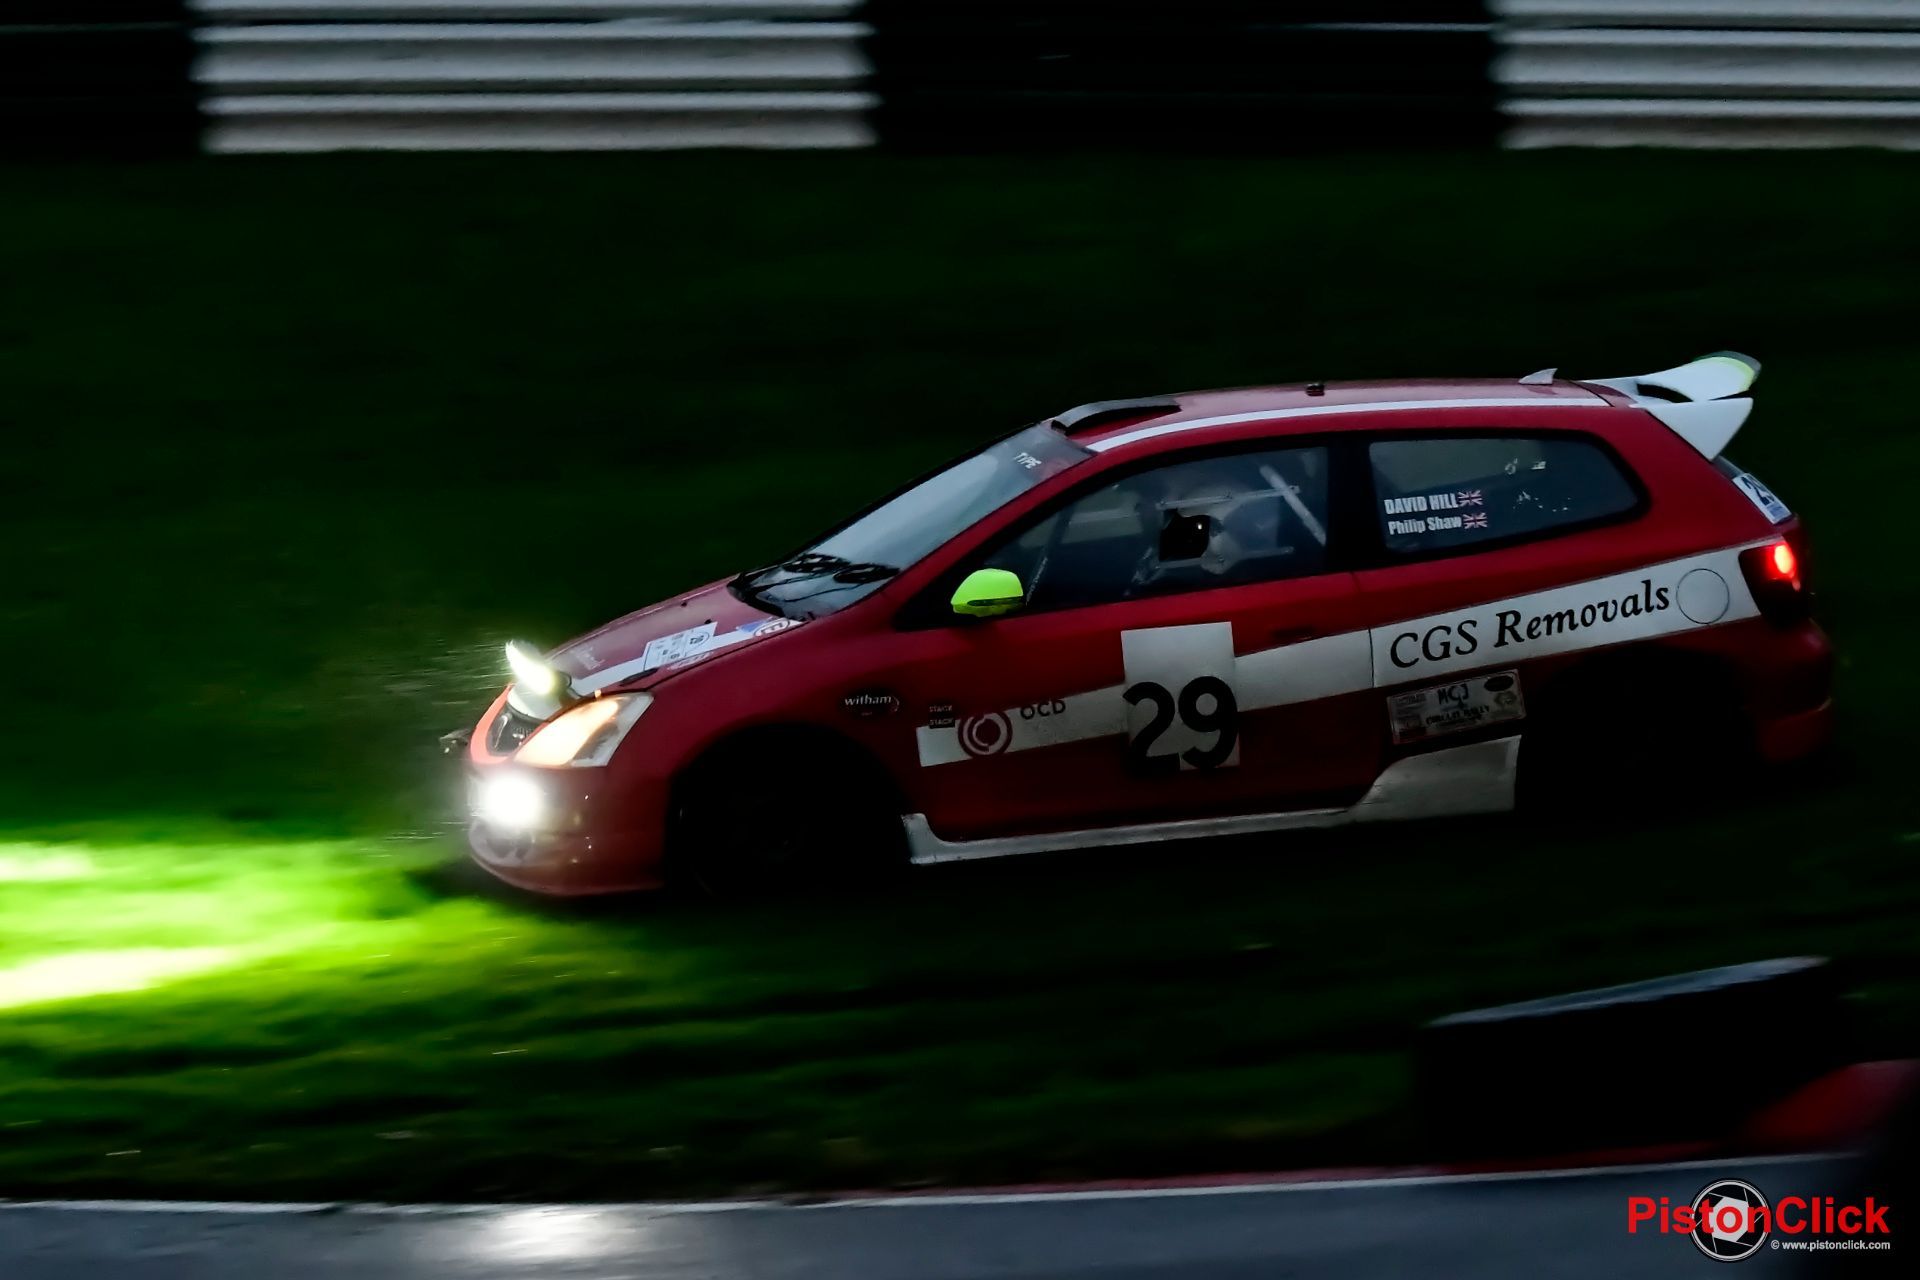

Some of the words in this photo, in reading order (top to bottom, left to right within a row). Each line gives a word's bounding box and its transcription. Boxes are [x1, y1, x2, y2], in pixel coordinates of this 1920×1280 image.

[1384, 496, 1428, 515] DAVID
[1429, 492, 1458, 510] HILL
[1388, 518, 1426, 535] Philip
[1426, 516, 1462, 531] Shaw
[1390, 620, 1478, 668] CGS
[1493, 579, 1670, 647] Removals
[844, 694, 892, 706] witham
[1020, 698, 1067, 719] OCD
[1123, 675, 1238, 771] 29
